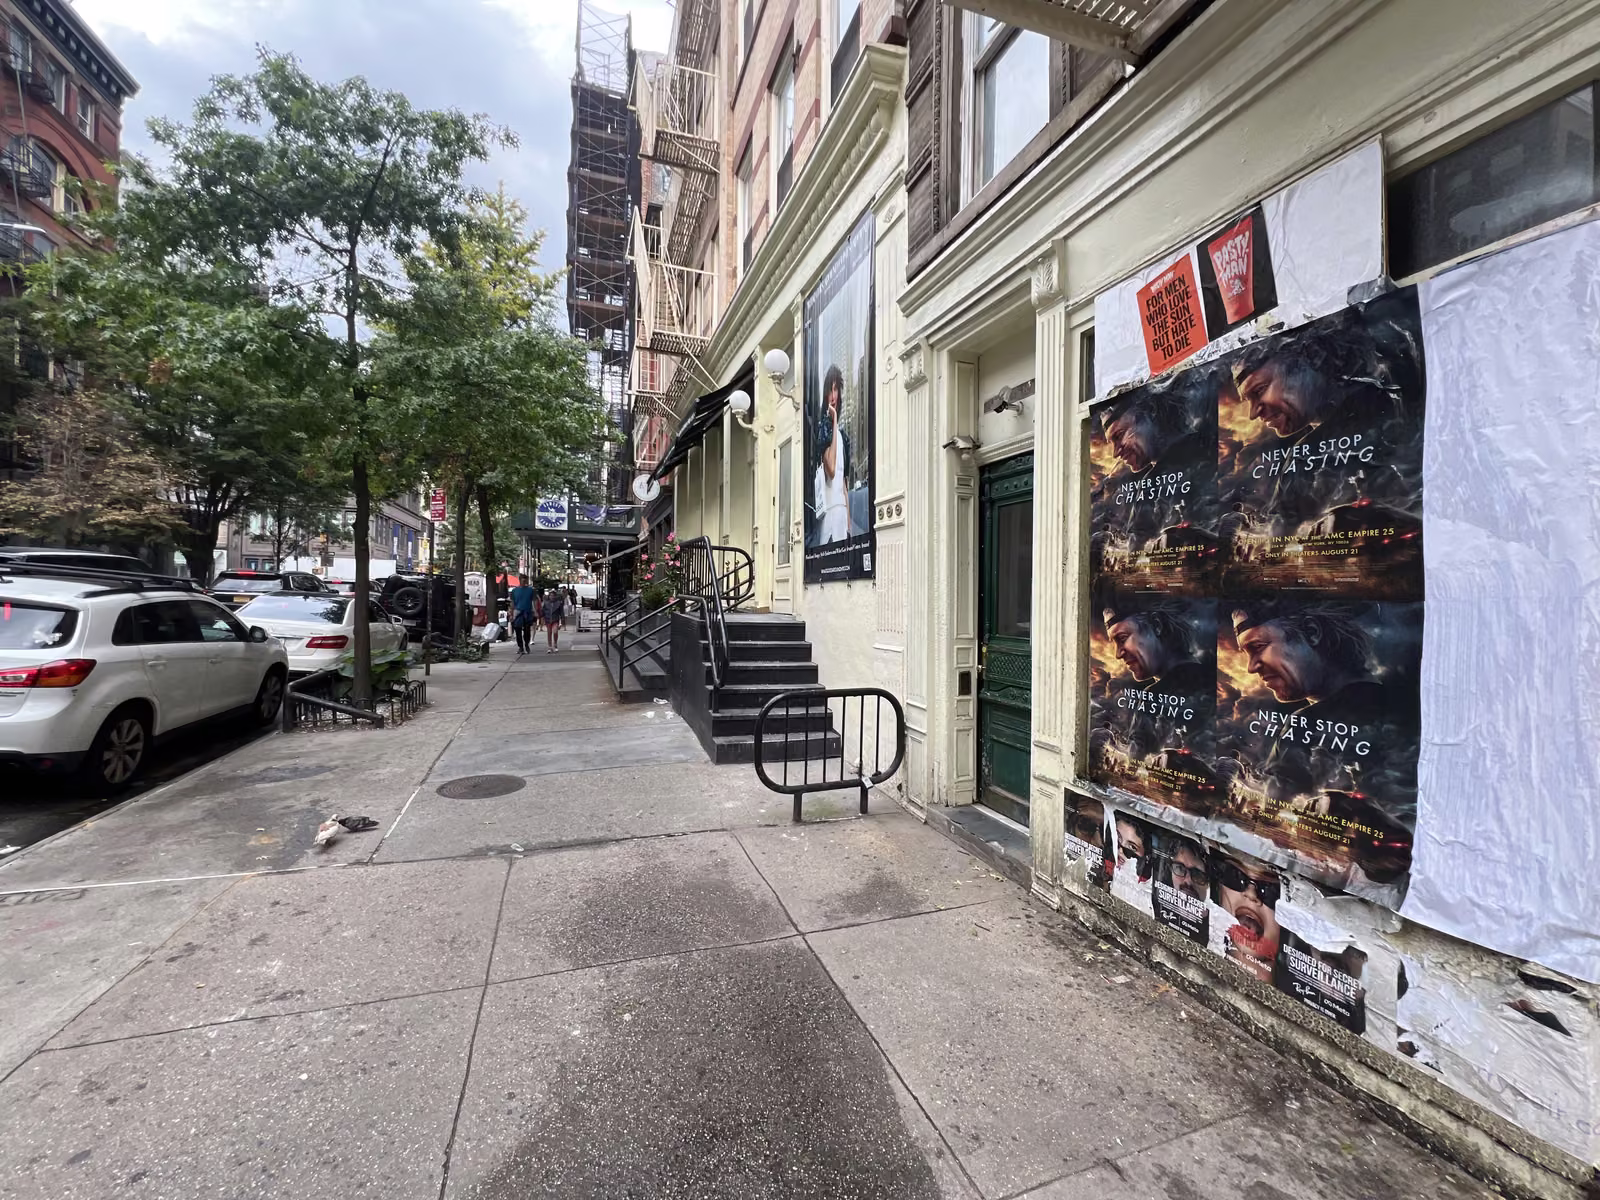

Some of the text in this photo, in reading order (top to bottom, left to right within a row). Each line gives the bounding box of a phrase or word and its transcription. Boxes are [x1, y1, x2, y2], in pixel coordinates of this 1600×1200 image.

[1146, 274, 1186, 312] FOR MEN
[1146, 285, 1192, 326] WHO LOVE
[1152, 302, 1190, 337] THE SUN
[1152, 313, 1196, 352] BUT HATE
[1161, 344, 1174, 361] TO
[1174, 332, 1191, 353] DIE
[1252, 446, 1374, 479] CHASING
[1262, 434, 1362, 463] NEVER STOP
[1115, 481, 1191, 505] CHASING
[1121, 471, 1183, 493] NEVER STOP
[1325, 531, 1345, 540] AMC
[1349, 528, 1379, 538] EMPIRE
[1382, 527, 1395, 536] 25
[1175, 545, 1196, 553] EMPIRE
[1117, 697, 1194, 720] CHASING
[1124, 687, 1186, 706] NEVER STOP
[1259, 709, 1359, 737] NEVER STOP
[1249, 721, 1371, 756] CHASING
[1174, 771, 1197, 782] EMPIRE
[1258, 810, 1273, 820] ONLY
[1314, 828, 1340, 841] AUGUST
[1267, 797, 1277, 805] IN
[1318, 813, 1338, 824] AMC
[1341, 819, 1372, 835] EMPIRE
[1374, 829, 1384, 839] 25
[1155, 880, 1177, 896] DESIGNED
[1178, 890, 1187, 901] FOR
[1188, 896, 1207, 911] SECRET
[1158, 890, 1203, 919] SURVEILLANCE
[1283, 943, 1317, 966] DESIGNED
[1317, 961, 1332, 975] FOR
[1333, 969, 1362, 990] SECRET
[1289, 956, 1356, 999] SURVEILLANCE
